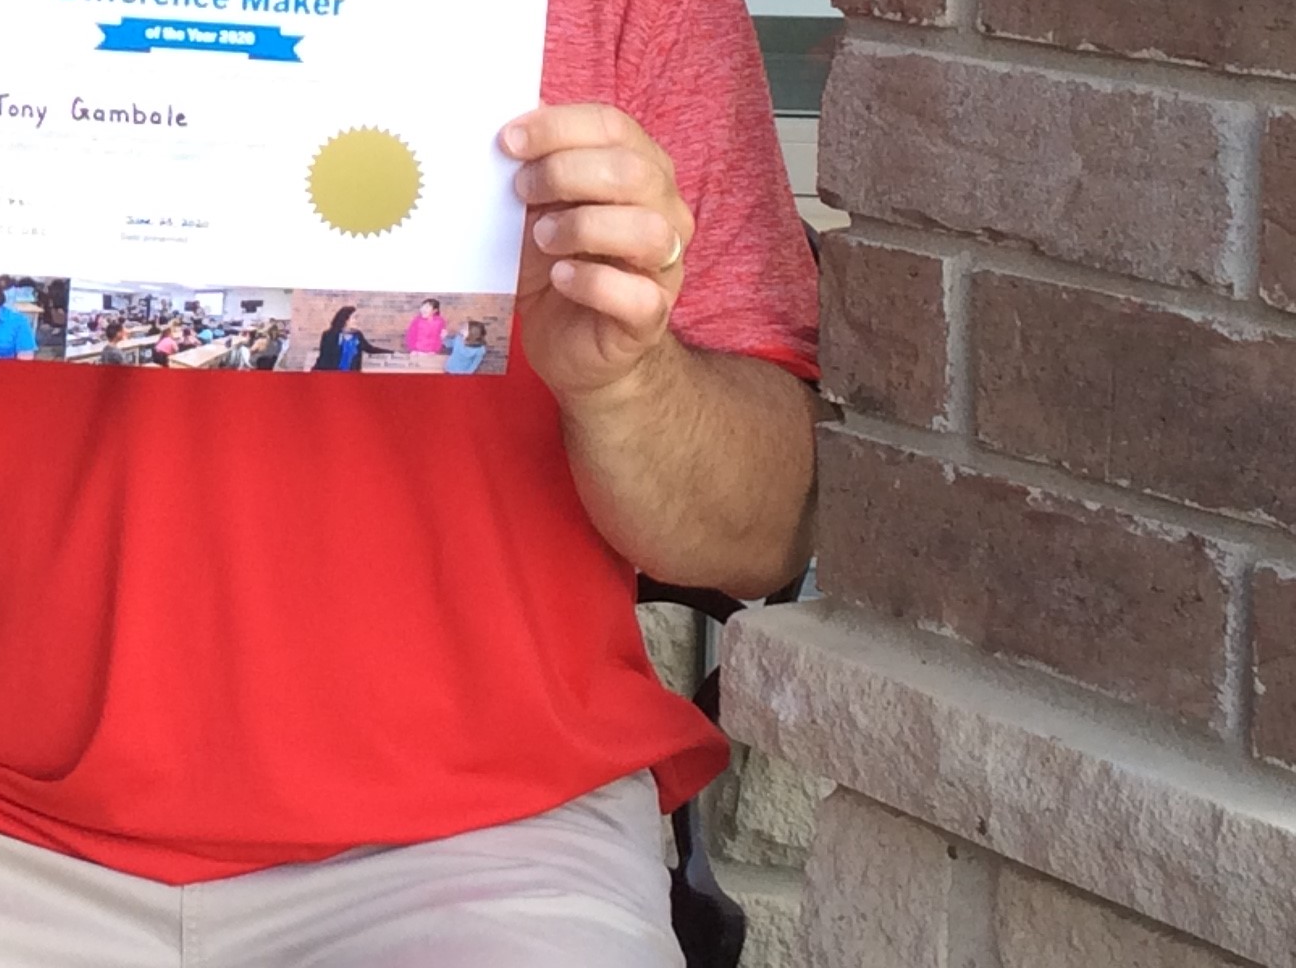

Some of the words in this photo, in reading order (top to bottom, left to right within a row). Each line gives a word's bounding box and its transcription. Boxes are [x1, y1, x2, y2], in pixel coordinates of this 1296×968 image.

[145, 26, 160, 40] of
[162, 27, 185, 41] the
[187, 27, 217, 43] Year
[218, 29, 256, 45] 2020
[71, 96, 188, 127] Gambale
